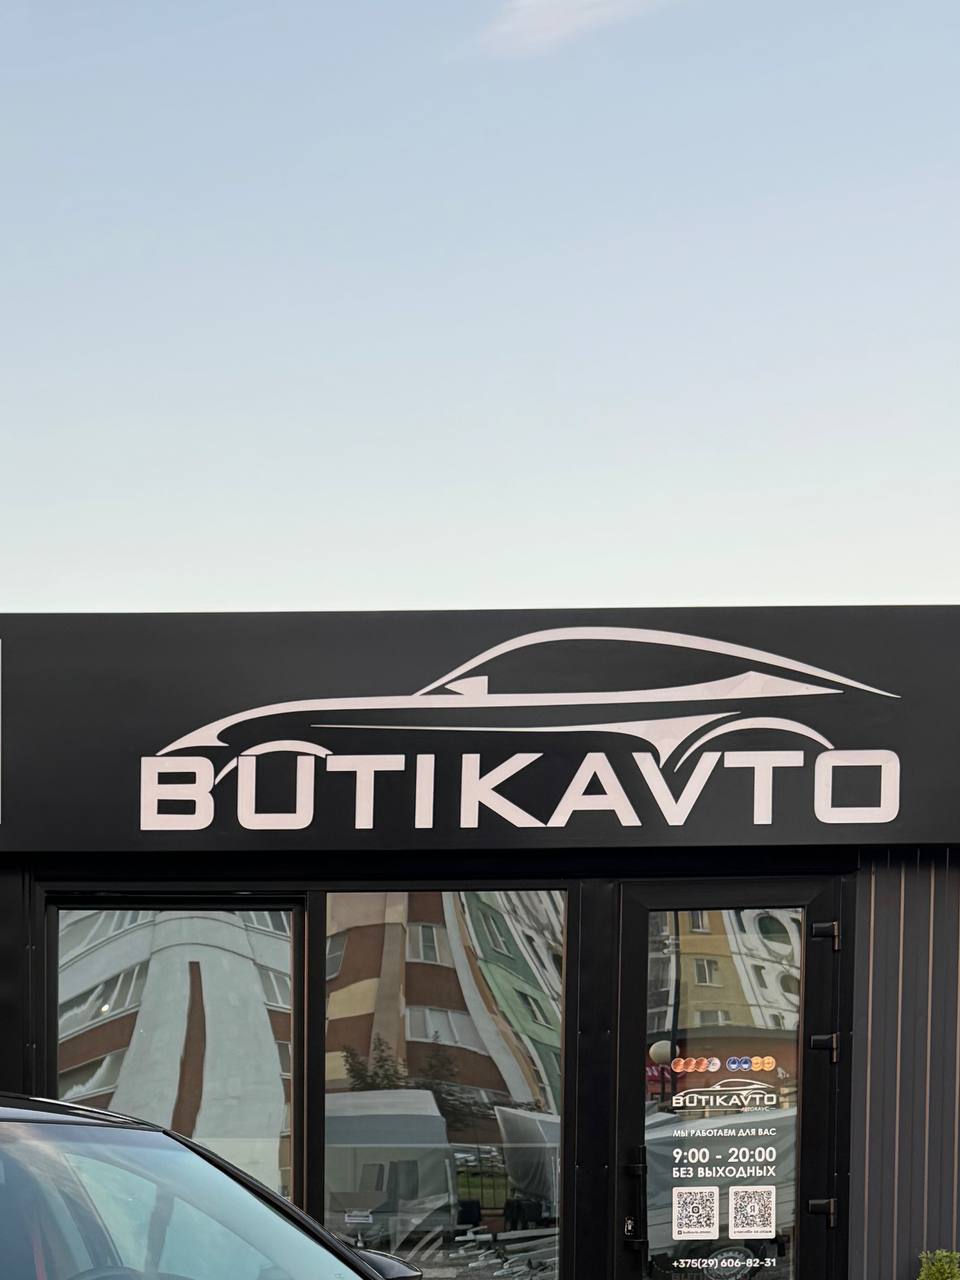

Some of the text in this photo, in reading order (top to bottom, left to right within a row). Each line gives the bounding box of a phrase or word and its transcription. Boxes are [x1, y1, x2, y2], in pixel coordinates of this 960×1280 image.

[140, 750, 900, 830] BUTIKAVTO
[672, 1094, 777, 1107] BUTIKAVTO
[673, 1128, 777, 1137] МЫ РАБОТАЕМ ДЛЯ ВАС
[672, 1148, 710, 1163] 9:00
[727, 1146, 777, 1162] 20:00
[672, 1165, 776, 1178] БЕЗ ВЫХОДНЫХ
[672, 1257, 776, 1269] +375(29) 606-82-31
